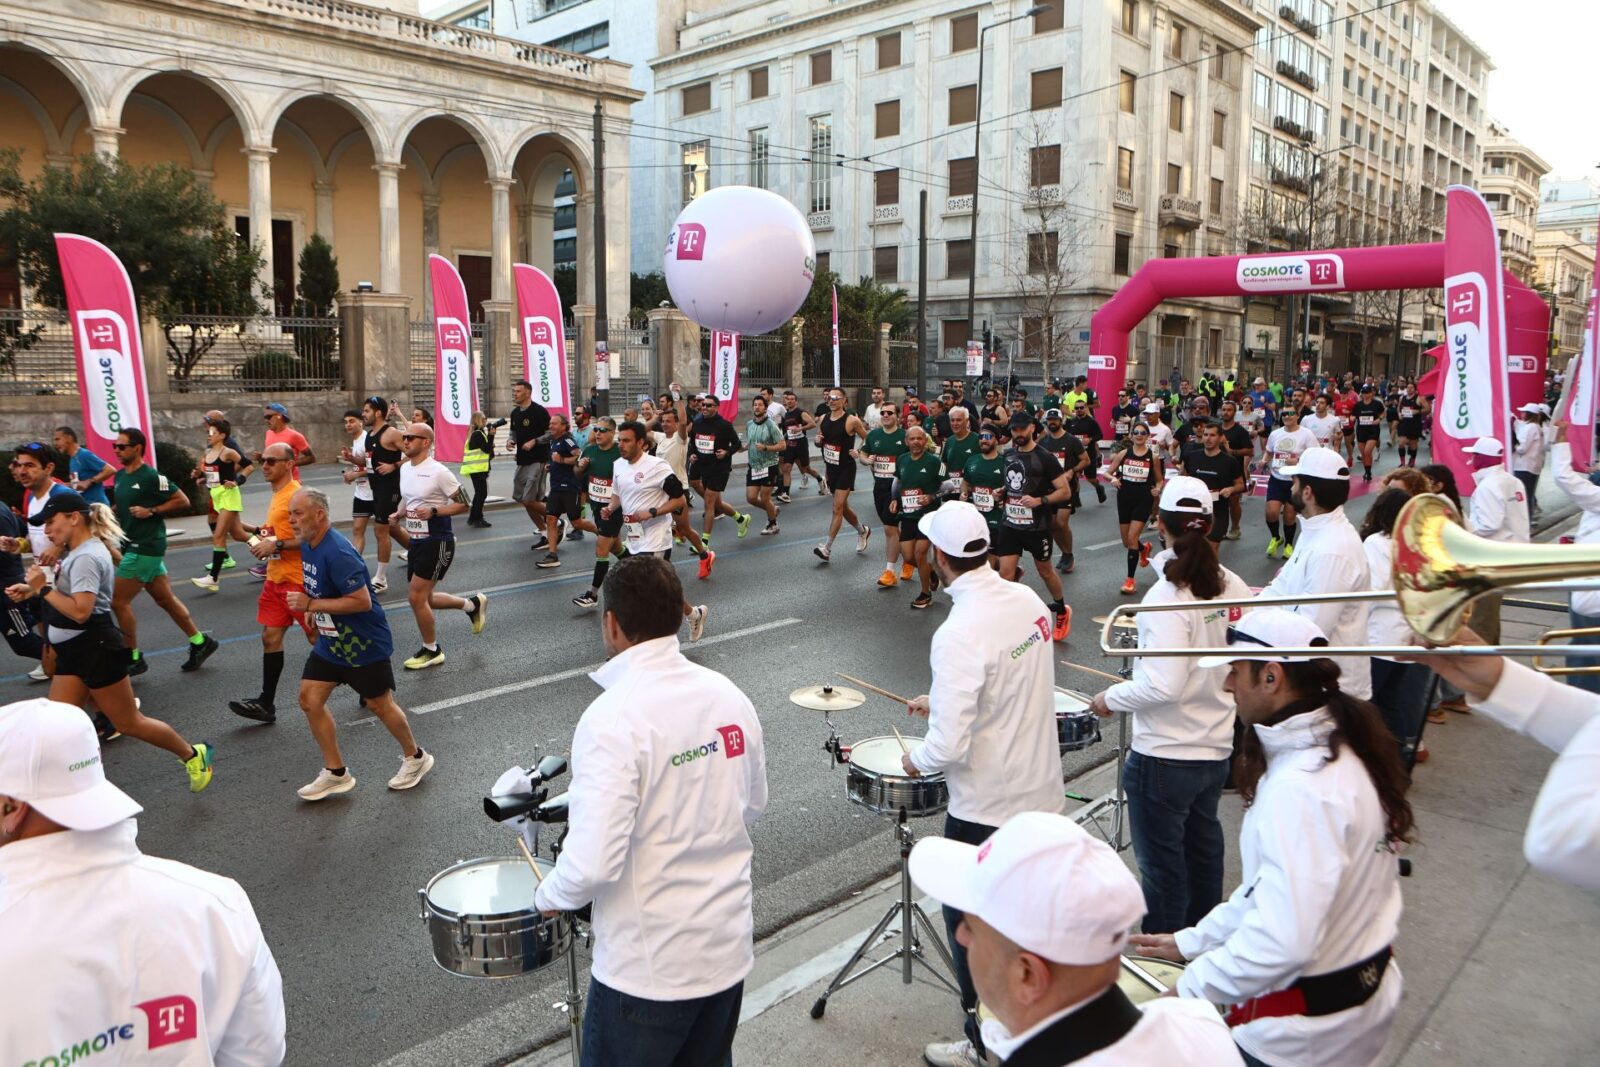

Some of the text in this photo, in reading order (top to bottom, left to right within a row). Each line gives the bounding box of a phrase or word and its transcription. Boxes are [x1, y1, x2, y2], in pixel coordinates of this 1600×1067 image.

[683, 230, 700, 252] T
[1242, 263, 1331, 280] COSMOTE T
[722, 351, 730, 397] COSMOTE
[593, 478, 608, 486] ERGO
[1010, 631, 1041, 660] COSMOTE
[671, 730, 740, 767] COSMOTE T
[69, 756, 100, 772] COSMOT
[158, 1003, 185, 1036] T
